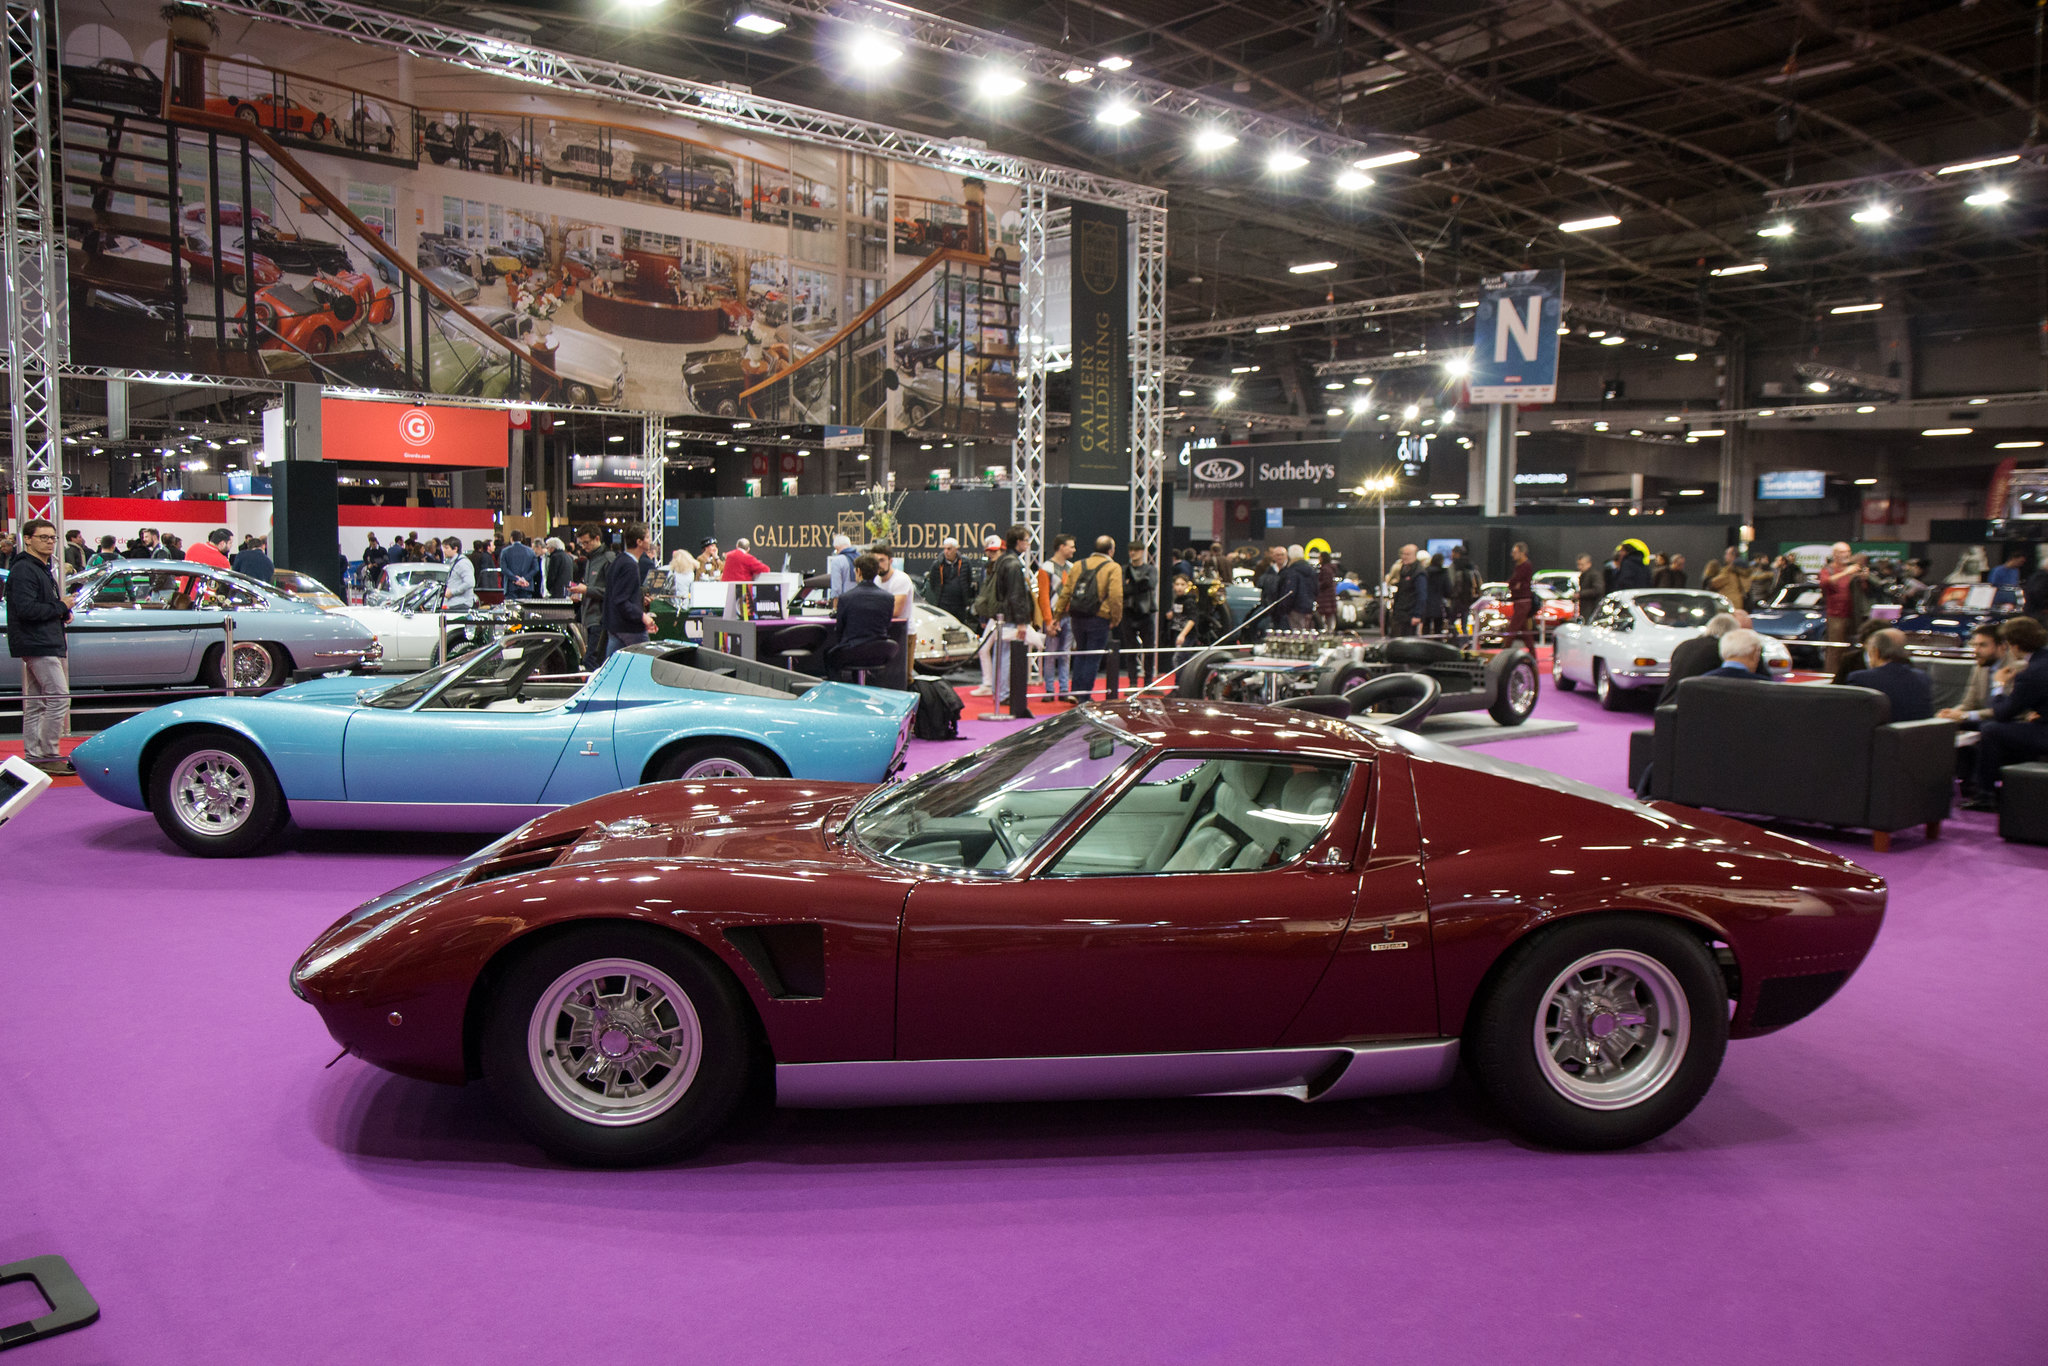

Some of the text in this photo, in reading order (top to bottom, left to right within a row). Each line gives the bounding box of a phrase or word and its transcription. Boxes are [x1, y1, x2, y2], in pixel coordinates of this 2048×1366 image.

[1494, 295, 1542, 362] N
[1096, 311, 1110, 453] AALDERING
[1080, 340, 1094, 452] GALLERY
[408, 418, 425, 438] G
[1259, 459, 1335, 484] Sotheby's
[753, 524, 834, 548] GALLERY
[908, 551, 938, 559] CLASSIC
[756, 601, 780, 612] MIURA
